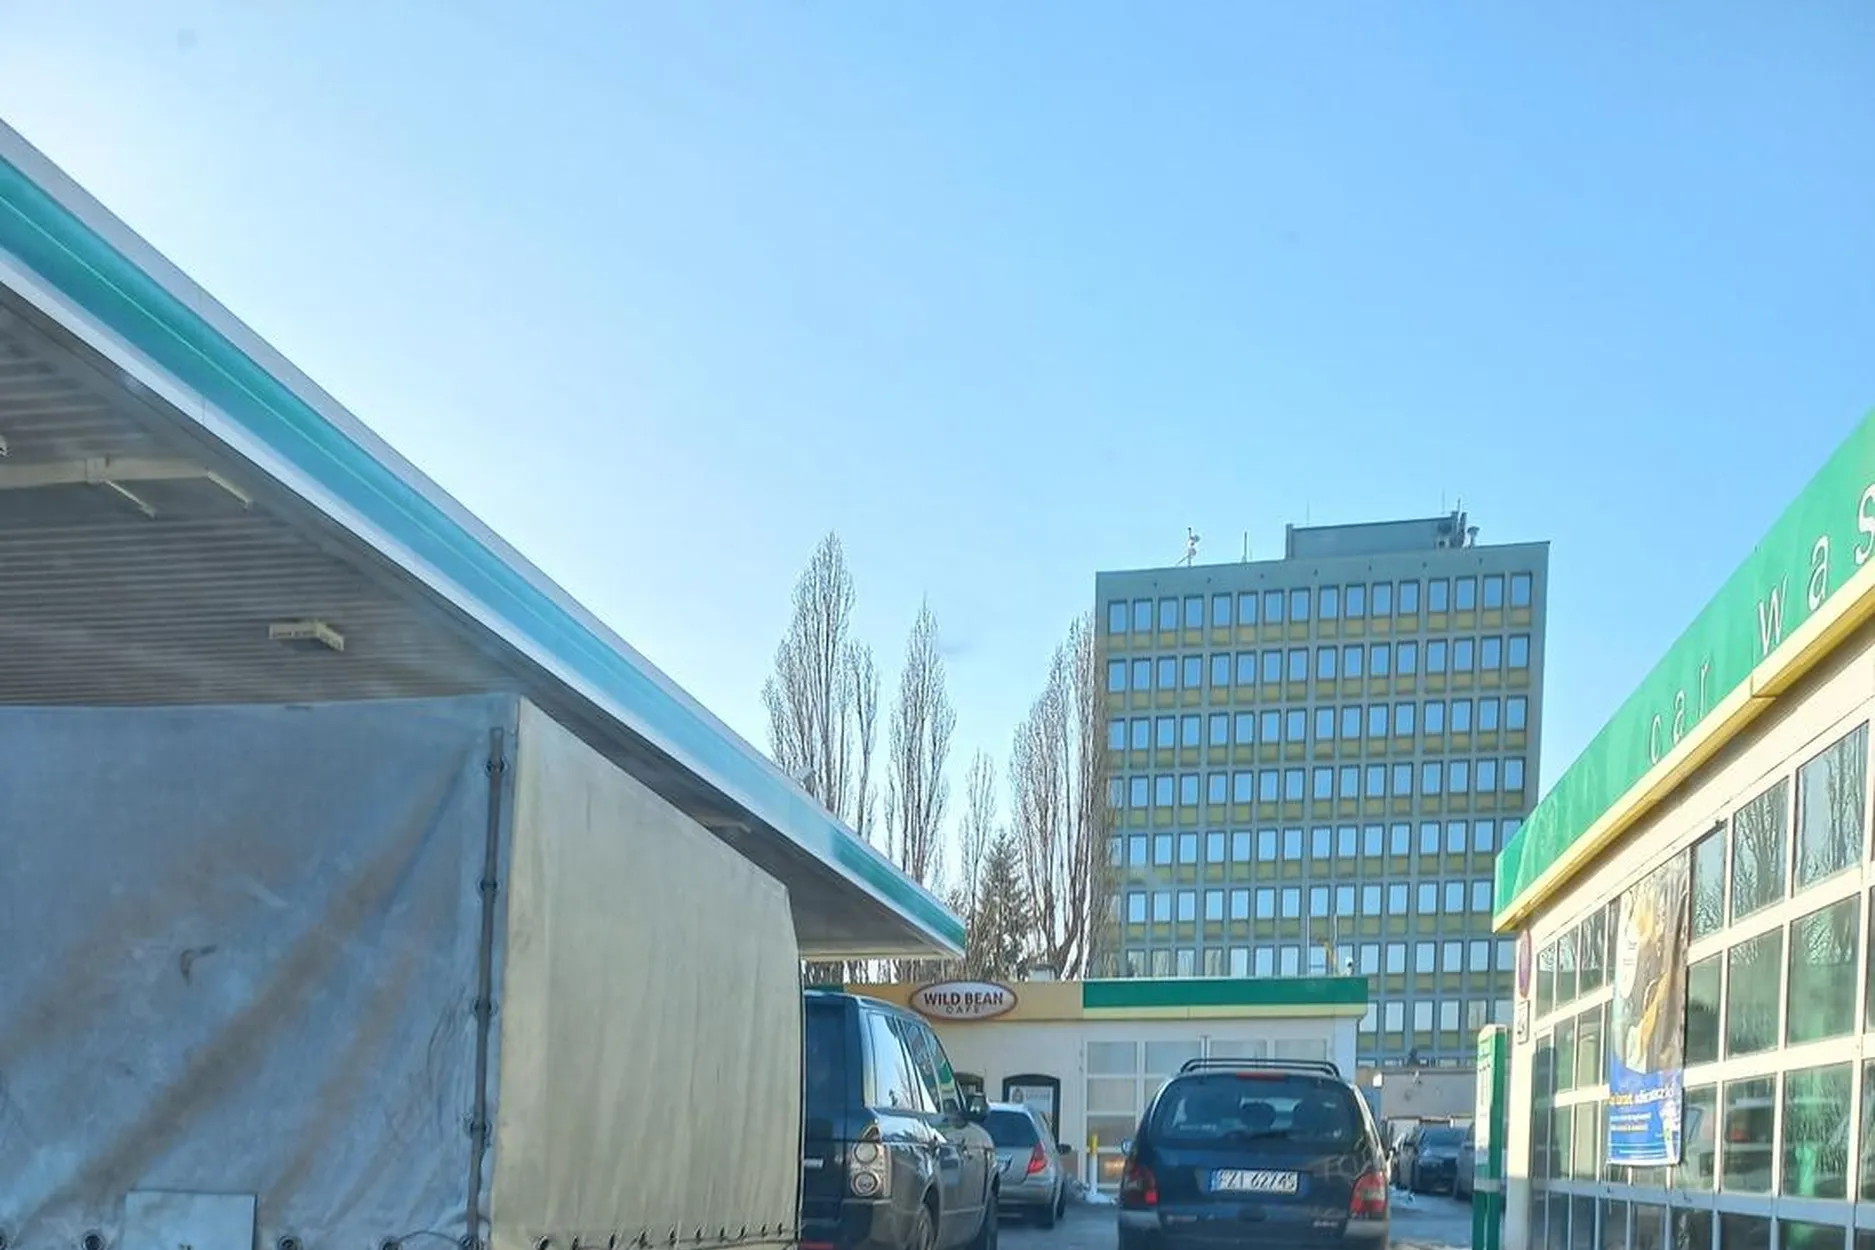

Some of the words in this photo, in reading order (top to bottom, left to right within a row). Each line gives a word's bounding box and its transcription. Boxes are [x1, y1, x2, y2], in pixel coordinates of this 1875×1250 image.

[1650, 655, 1710, 764] car
[924, 992, 960, 1006] WILD
[964, 992, 1004, 1005] BEAN
